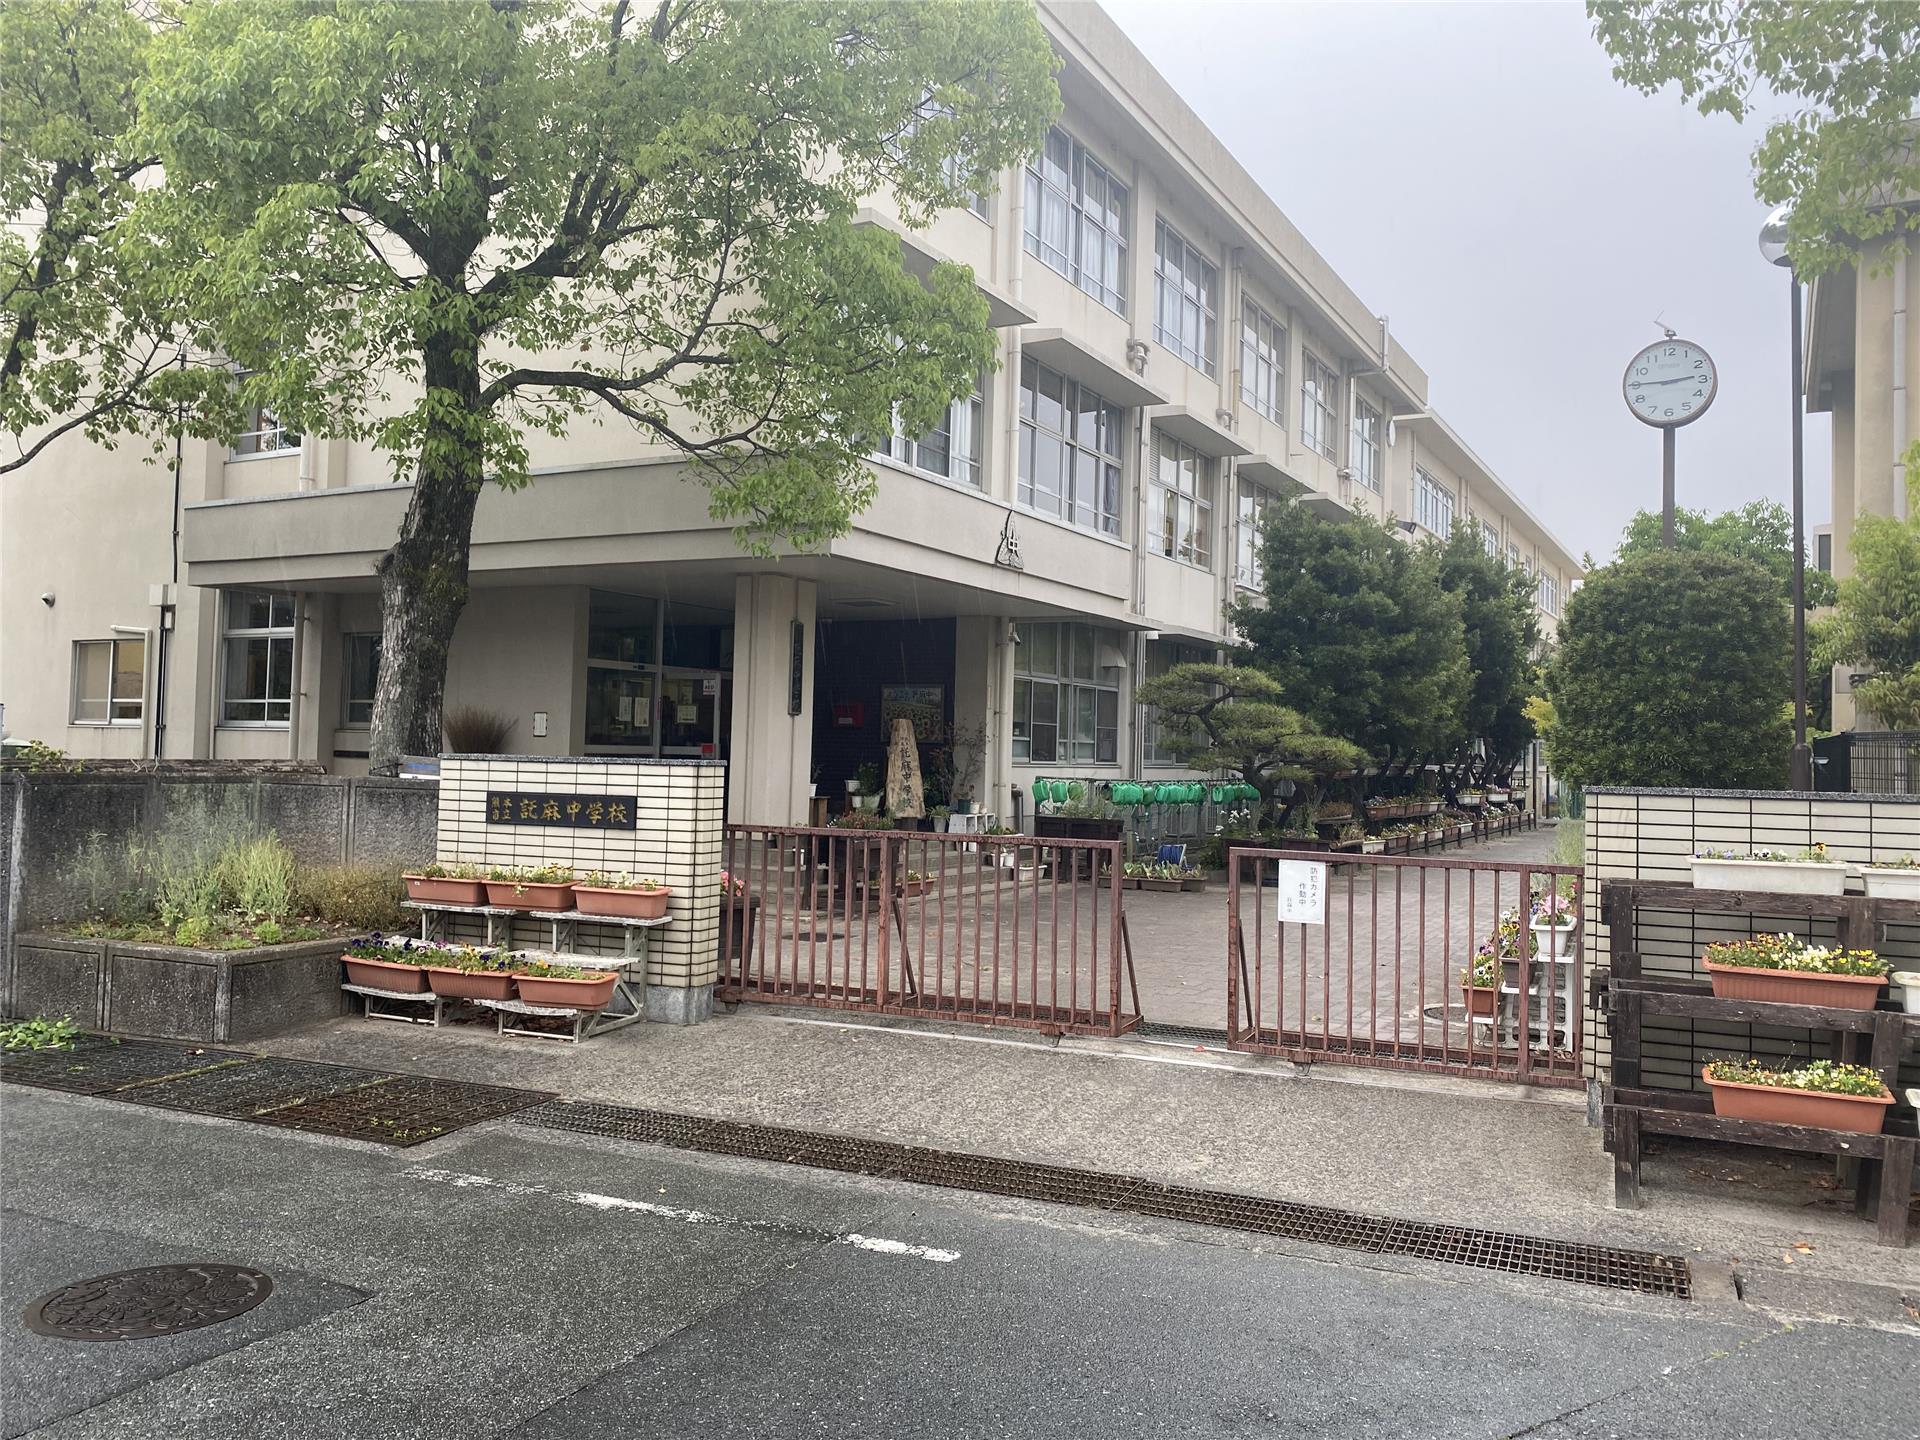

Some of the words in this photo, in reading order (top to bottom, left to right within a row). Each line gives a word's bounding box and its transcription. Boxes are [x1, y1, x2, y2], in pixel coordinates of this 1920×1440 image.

[1663, 347, 1676, 357] 12
[1646, 354, 1658, 363] 11
[1693, 359, 1703, 369] 2
[1635, 367, 1648, 376] 10
[1698, 374, 1708, 383] 3
[1631, 381, 1641, 390] 9
[1692, 388, 1704, 397] 4
[1635, 394, 1646, 403] 8
[1648, 405, 1658, 415] 7
[1681, 402, 1692, 411] 5
[1663, 408, 1674, 417] 6
[519, 797, 628, 825] 託麻中学校
